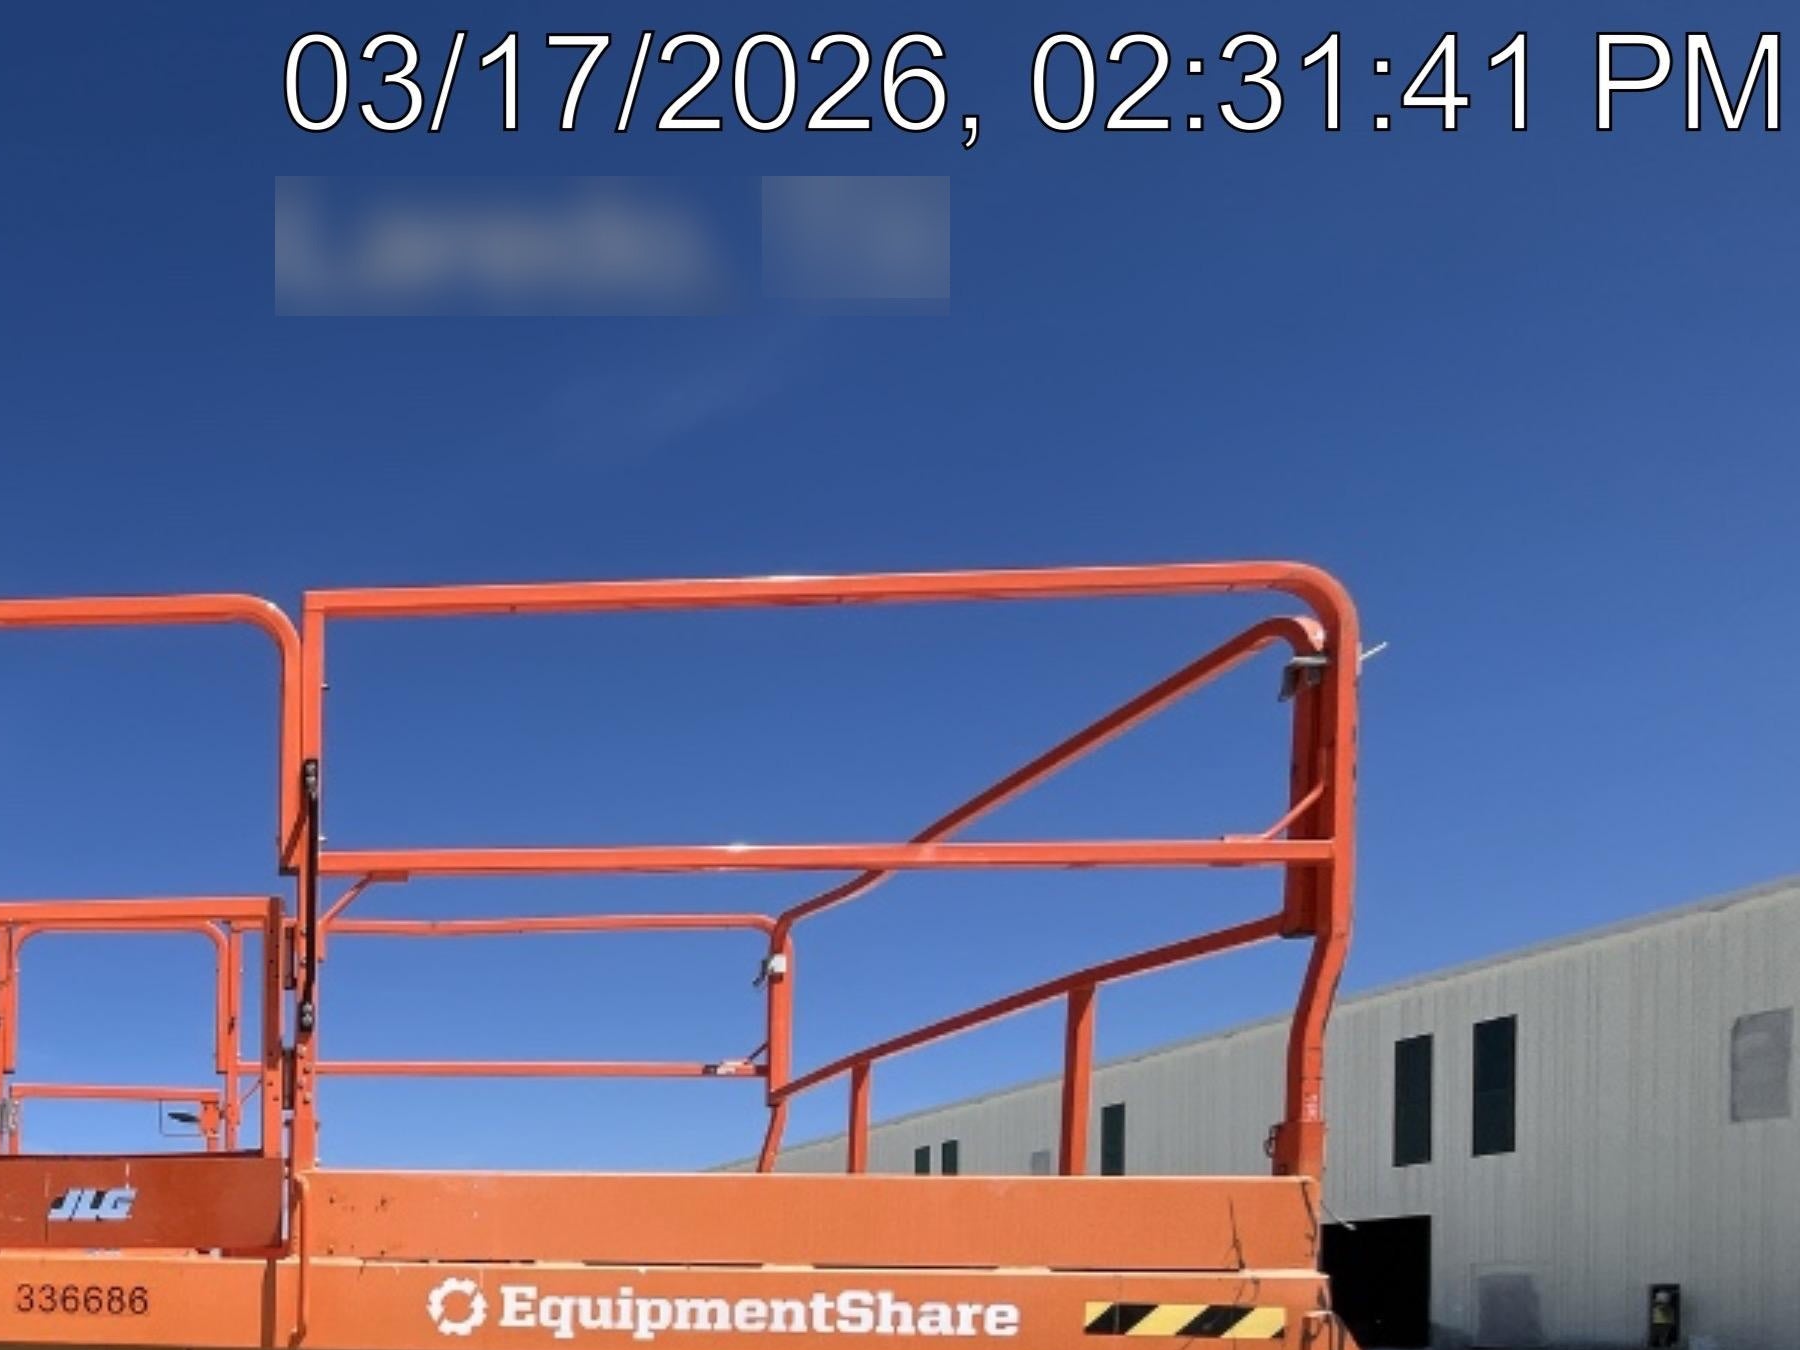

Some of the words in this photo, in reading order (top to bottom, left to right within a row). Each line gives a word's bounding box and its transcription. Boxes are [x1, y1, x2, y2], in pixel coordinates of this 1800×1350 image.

[47, 1187, 137, 1221] JLG
[16, 1283, 149, 1315] 336686
[499, 1284, 1021, 1339] EquipmentShare
